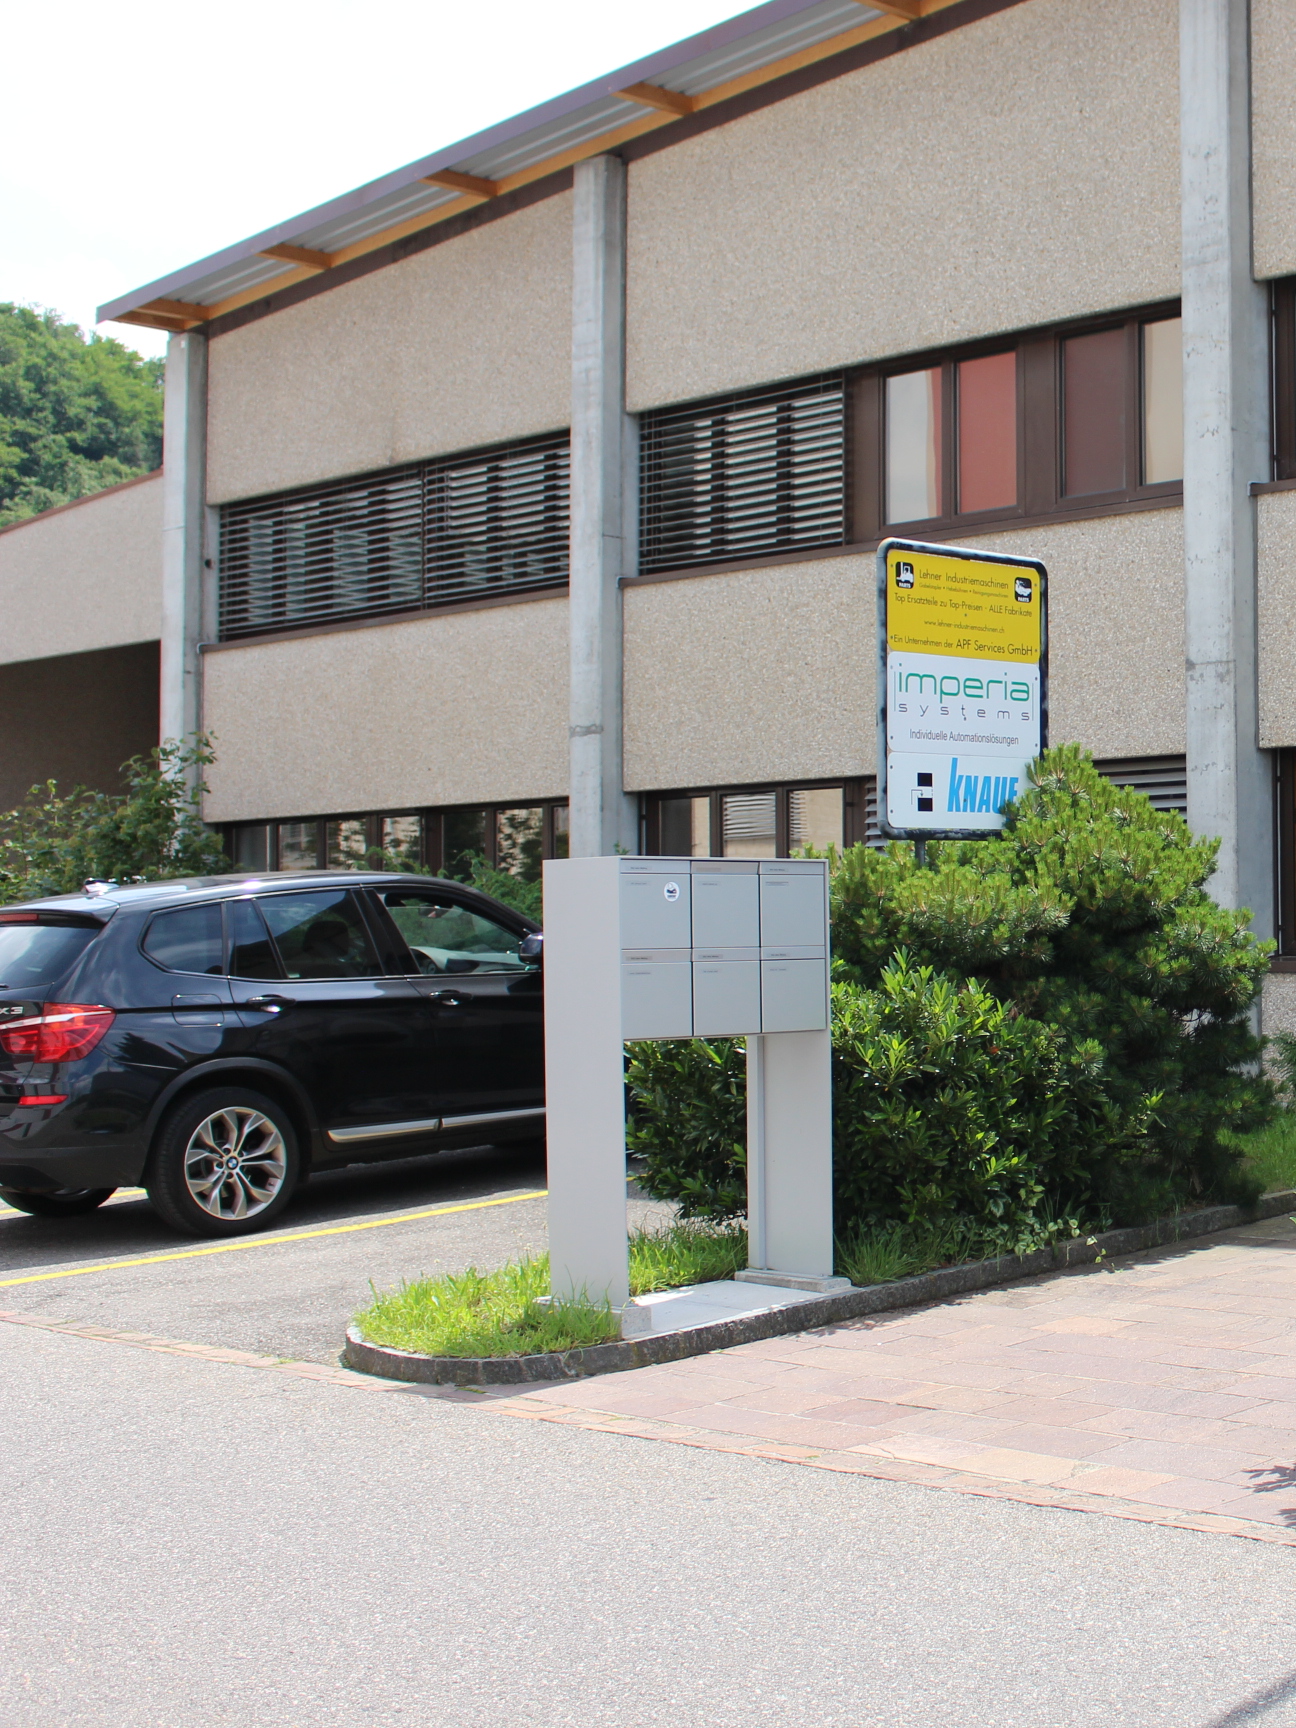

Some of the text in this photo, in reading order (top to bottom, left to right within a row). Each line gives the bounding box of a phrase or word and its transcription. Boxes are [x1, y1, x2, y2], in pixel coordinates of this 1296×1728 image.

[919, 569, 1009, 590] Lehner Industriemaschinen
[894, 592, 906, 603] Top
[907, 594, 938, 607] Ersatzteile
[949, 599, 983, 612] Top-Preisen
[989, 604, 1003, 614] ALLE
[1004, 606, 1032, 617] Fabrikate
[924, 619, 1005, 634] www.lehner-industriemaschinen.ch
[893, 634, 1033, 656] Ein Unternehmen der APF Services GmbH
[898, 662, 1030, 704] imperia
[898, 703, 1030, 721] systems
[909, 728, 1019, 748] Individuelle Automationslösungen
[0, 1006, 23, 1015] 8,0
